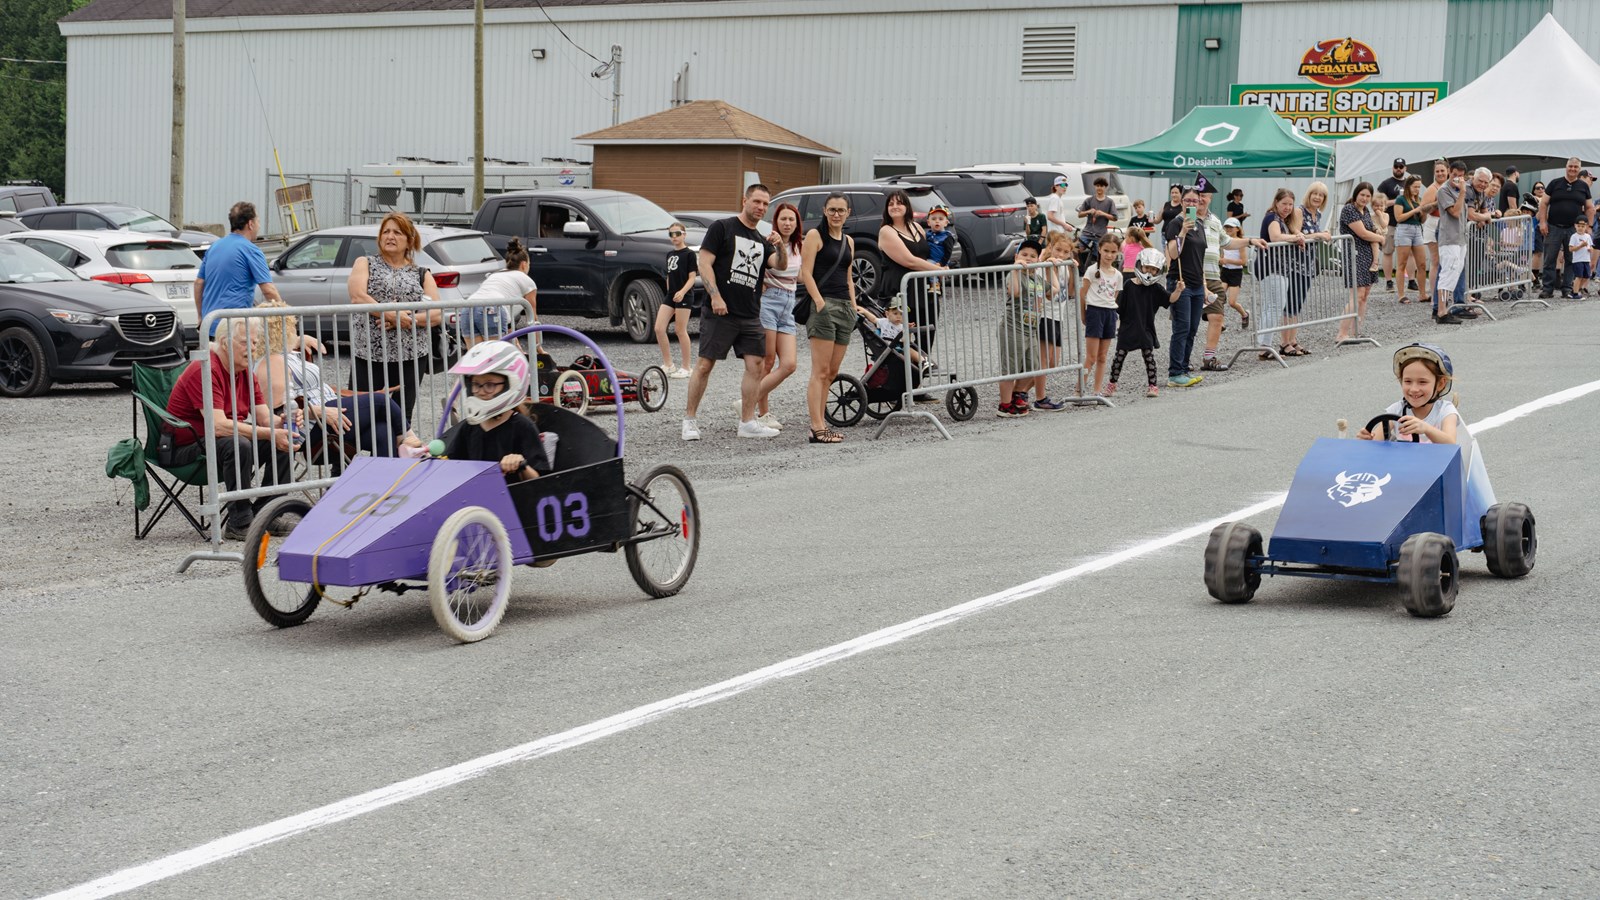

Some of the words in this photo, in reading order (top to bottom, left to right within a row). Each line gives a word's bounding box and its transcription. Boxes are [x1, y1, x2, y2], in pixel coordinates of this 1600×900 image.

[1242, 92, 1329, 112] CENTRE
[1335, 91, 1435, 111] SPORTIF
[1187, 156, 1233, 167] Desjardins
[536, 492, 591, 542] 03
